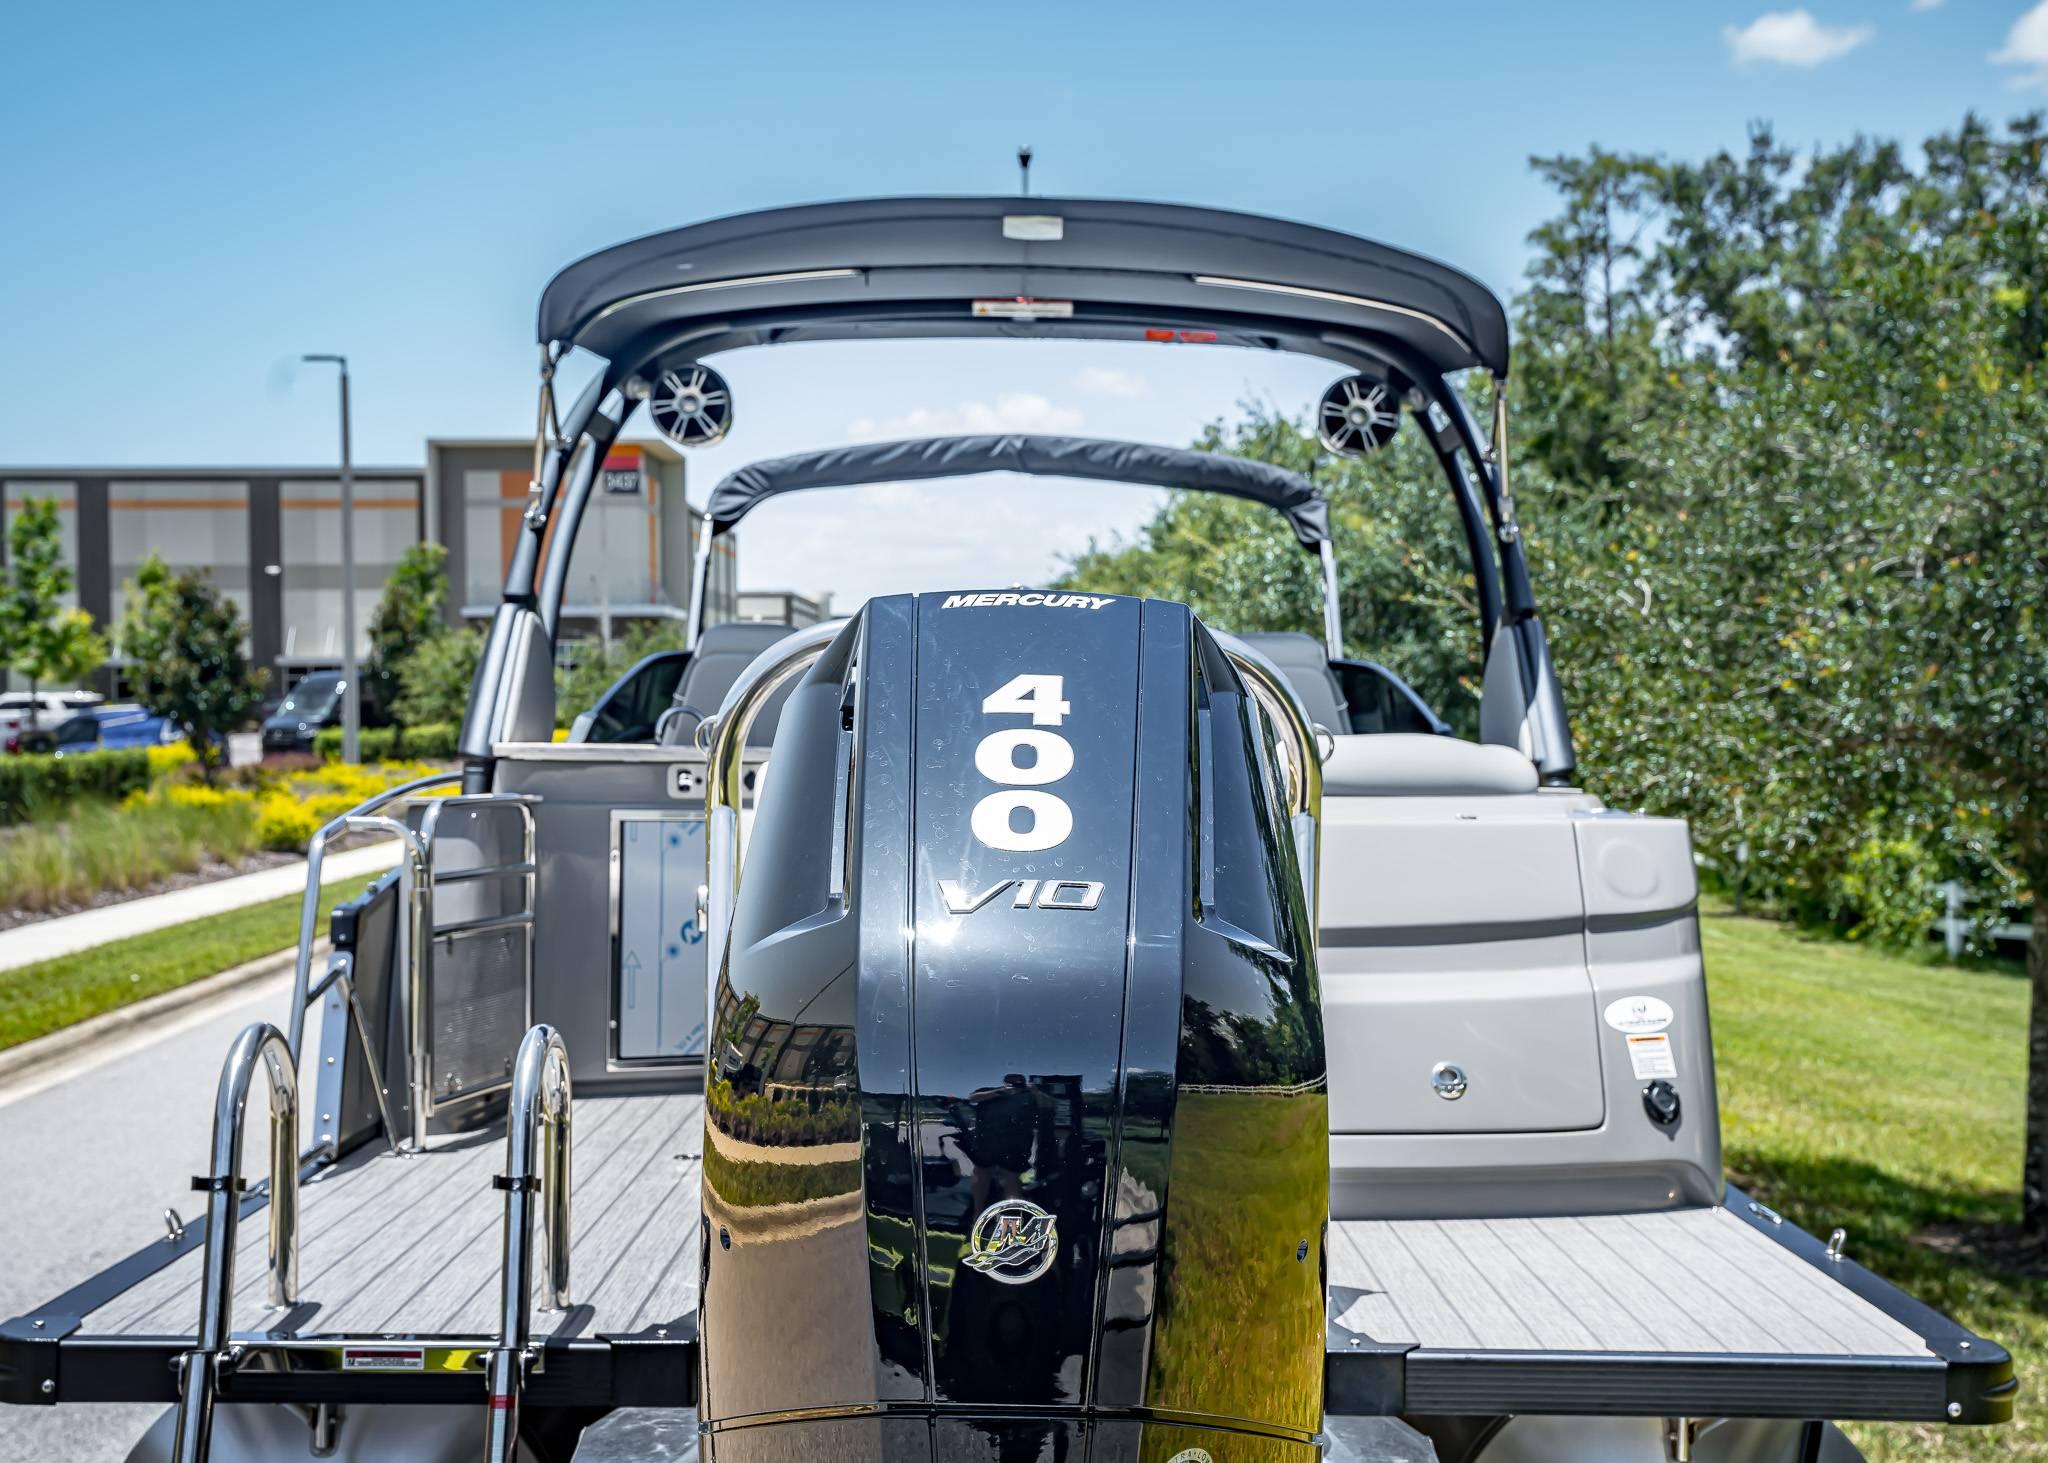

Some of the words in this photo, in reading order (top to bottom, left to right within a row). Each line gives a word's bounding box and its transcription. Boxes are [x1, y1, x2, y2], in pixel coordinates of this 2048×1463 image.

[941, 593, 1117, 610] MERCURY
[970, 673, 1075, 852] 400
[937, 879, 1105, 914] V10
